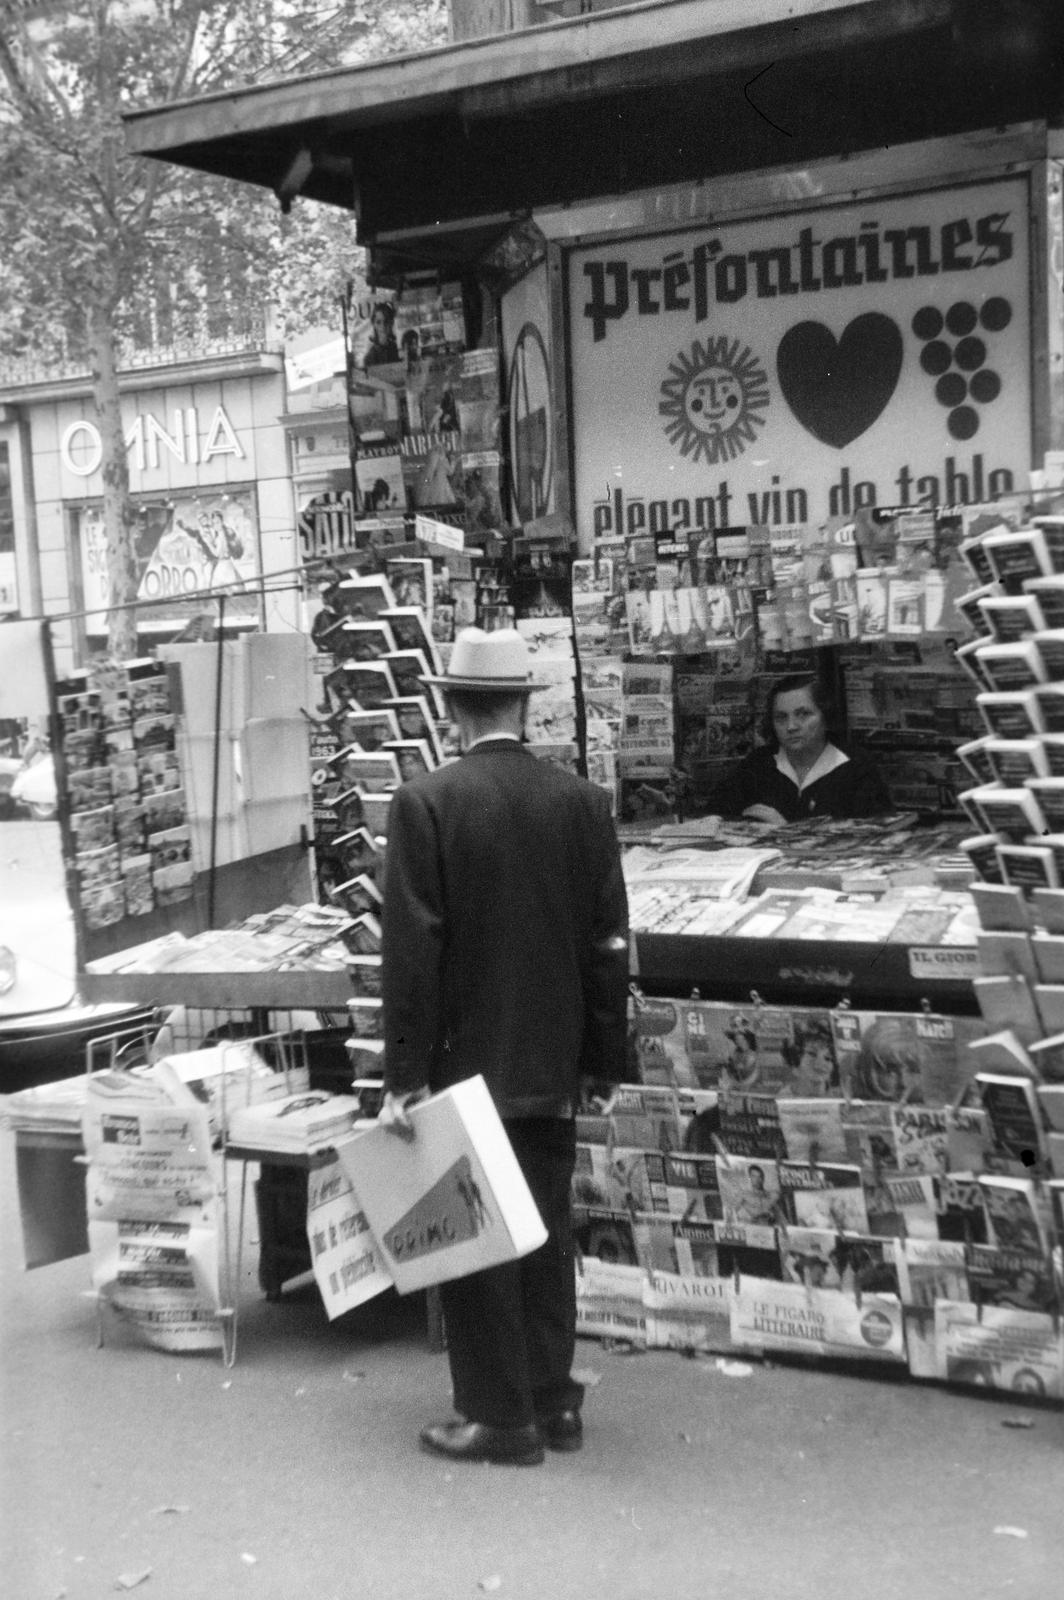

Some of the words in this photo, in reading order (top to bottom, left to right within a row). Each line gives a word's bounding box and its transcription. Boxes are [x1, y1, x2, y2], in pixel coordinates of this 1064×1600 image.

[583, 211, 1014, 342] préfontaines
[747, 475, 808, 526] vin
[829, 467, 877, 516] de
[895, 453, 1015, 510] table
[913, 952, 932, 962] IL
[754, 1302, 769, 1316] LE
[775, 1306, 825, 1325] FIGARO
